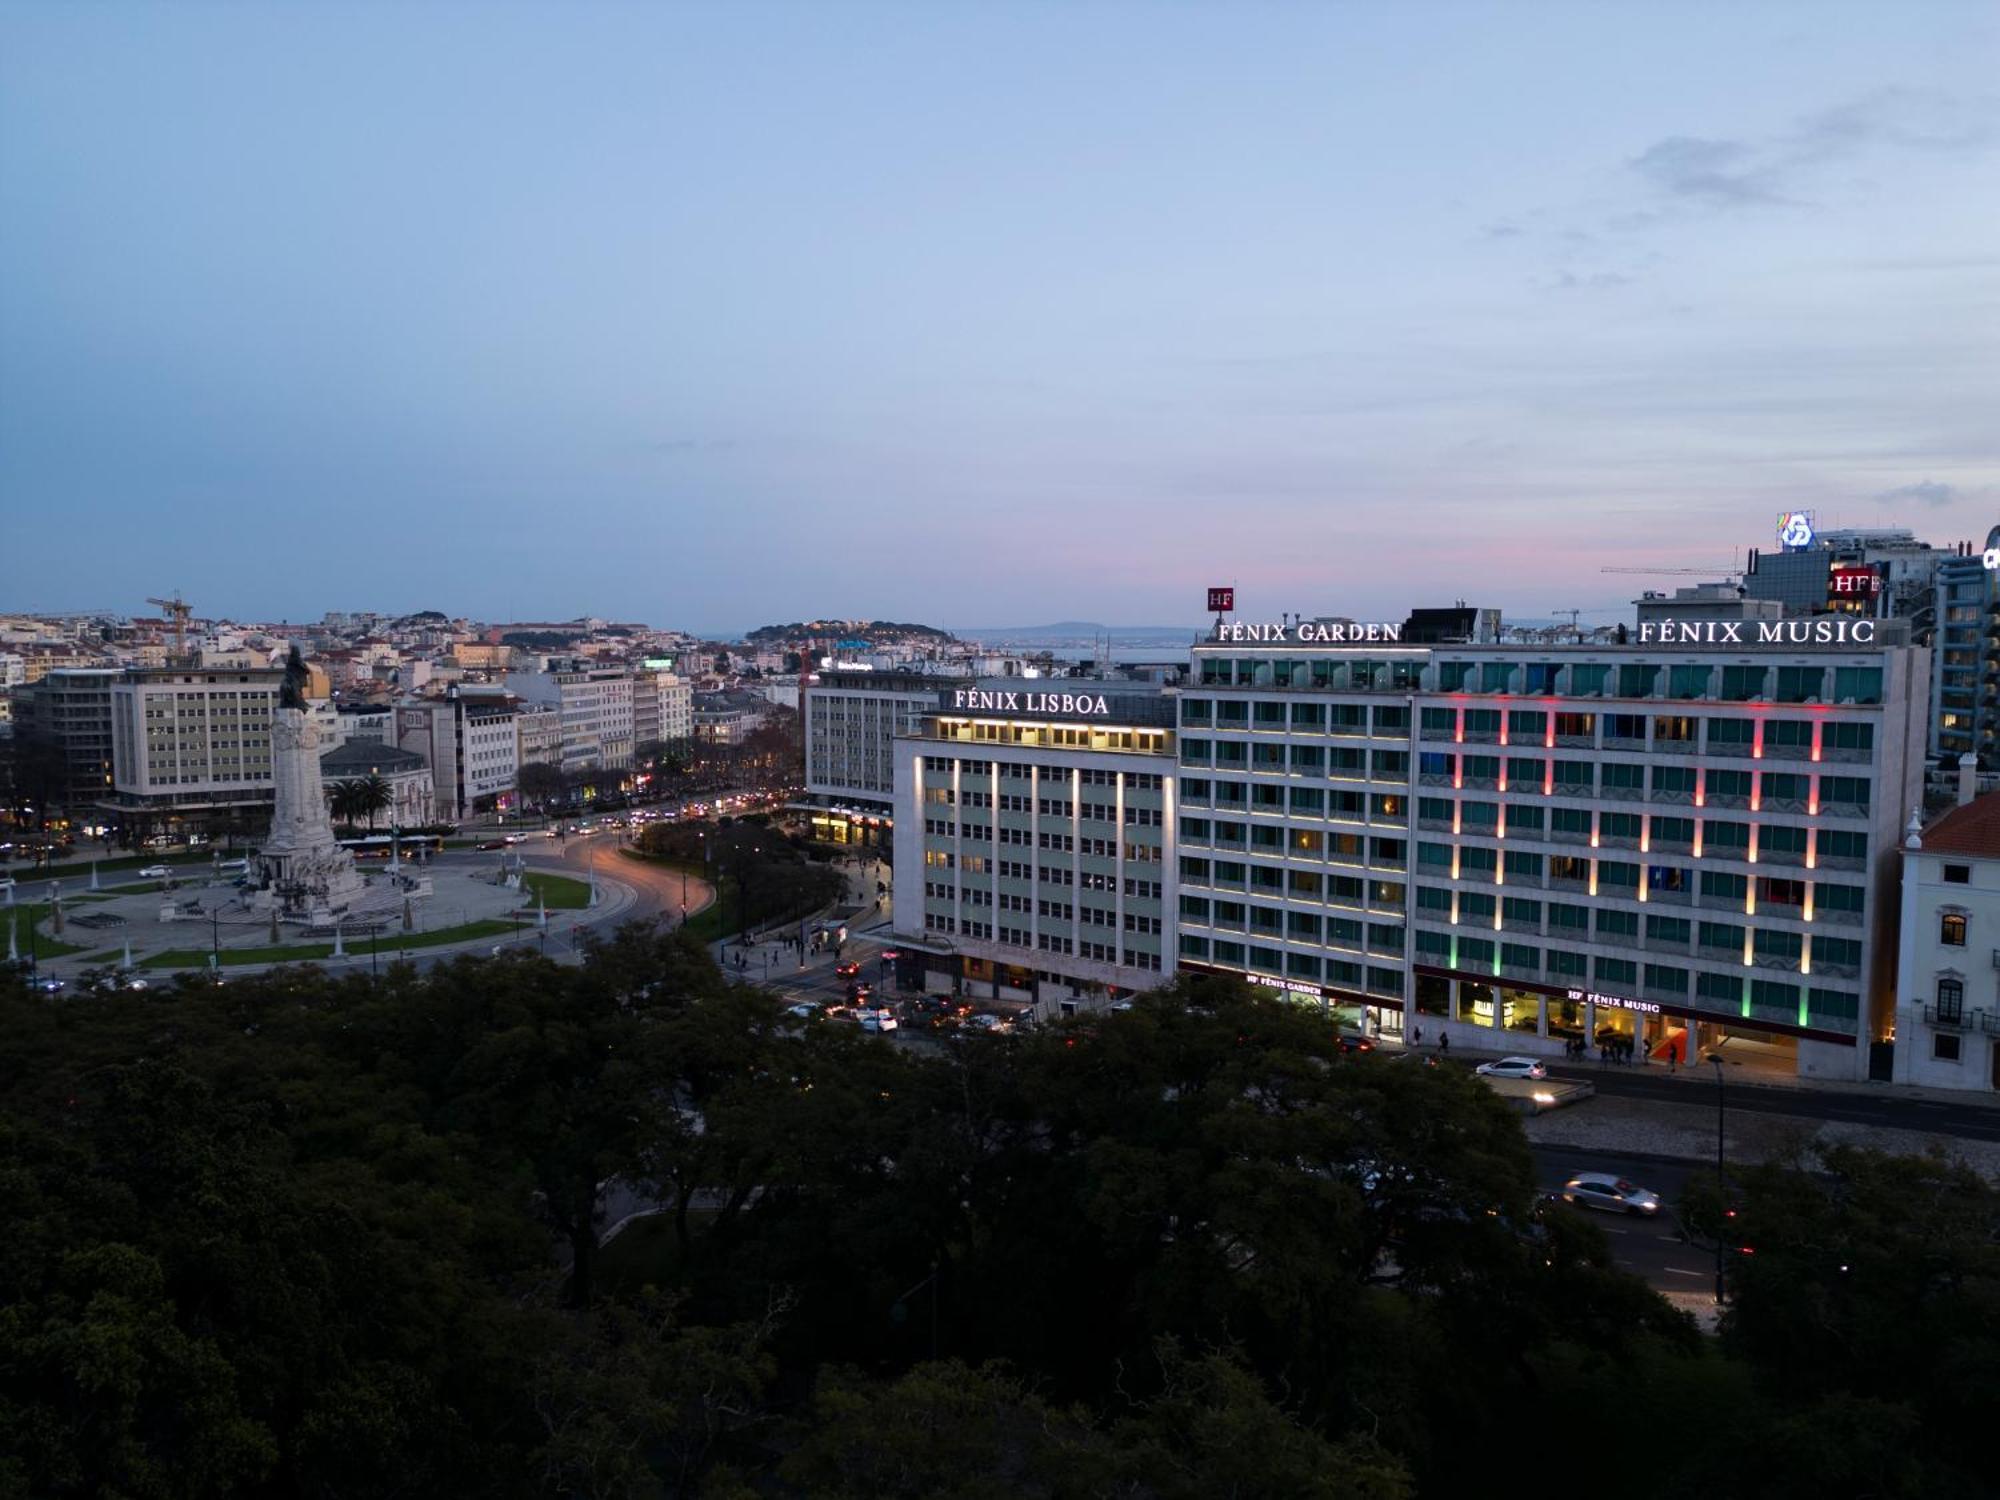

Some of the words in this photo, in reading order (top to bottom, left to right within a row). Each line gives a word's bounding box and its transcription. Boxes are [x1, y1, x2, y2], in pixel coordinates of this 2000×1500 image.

[1834, 575, 1869, 592] HF
[1210, 593, 1232, 605] HF
[1219, 621, 1286, 641] FÉNIX
[1299, 623, 1401, 641] GARDEN
[1639, 618, 1742, 642] FÉNIX
[1757, 620, 1874, 643] MUSIC
[955, 687, 1018, 710] FÉNIX
[1027, 693, 1109, 714] LISBOA
[1623, 1000, 1660, 1013] MUSIC
